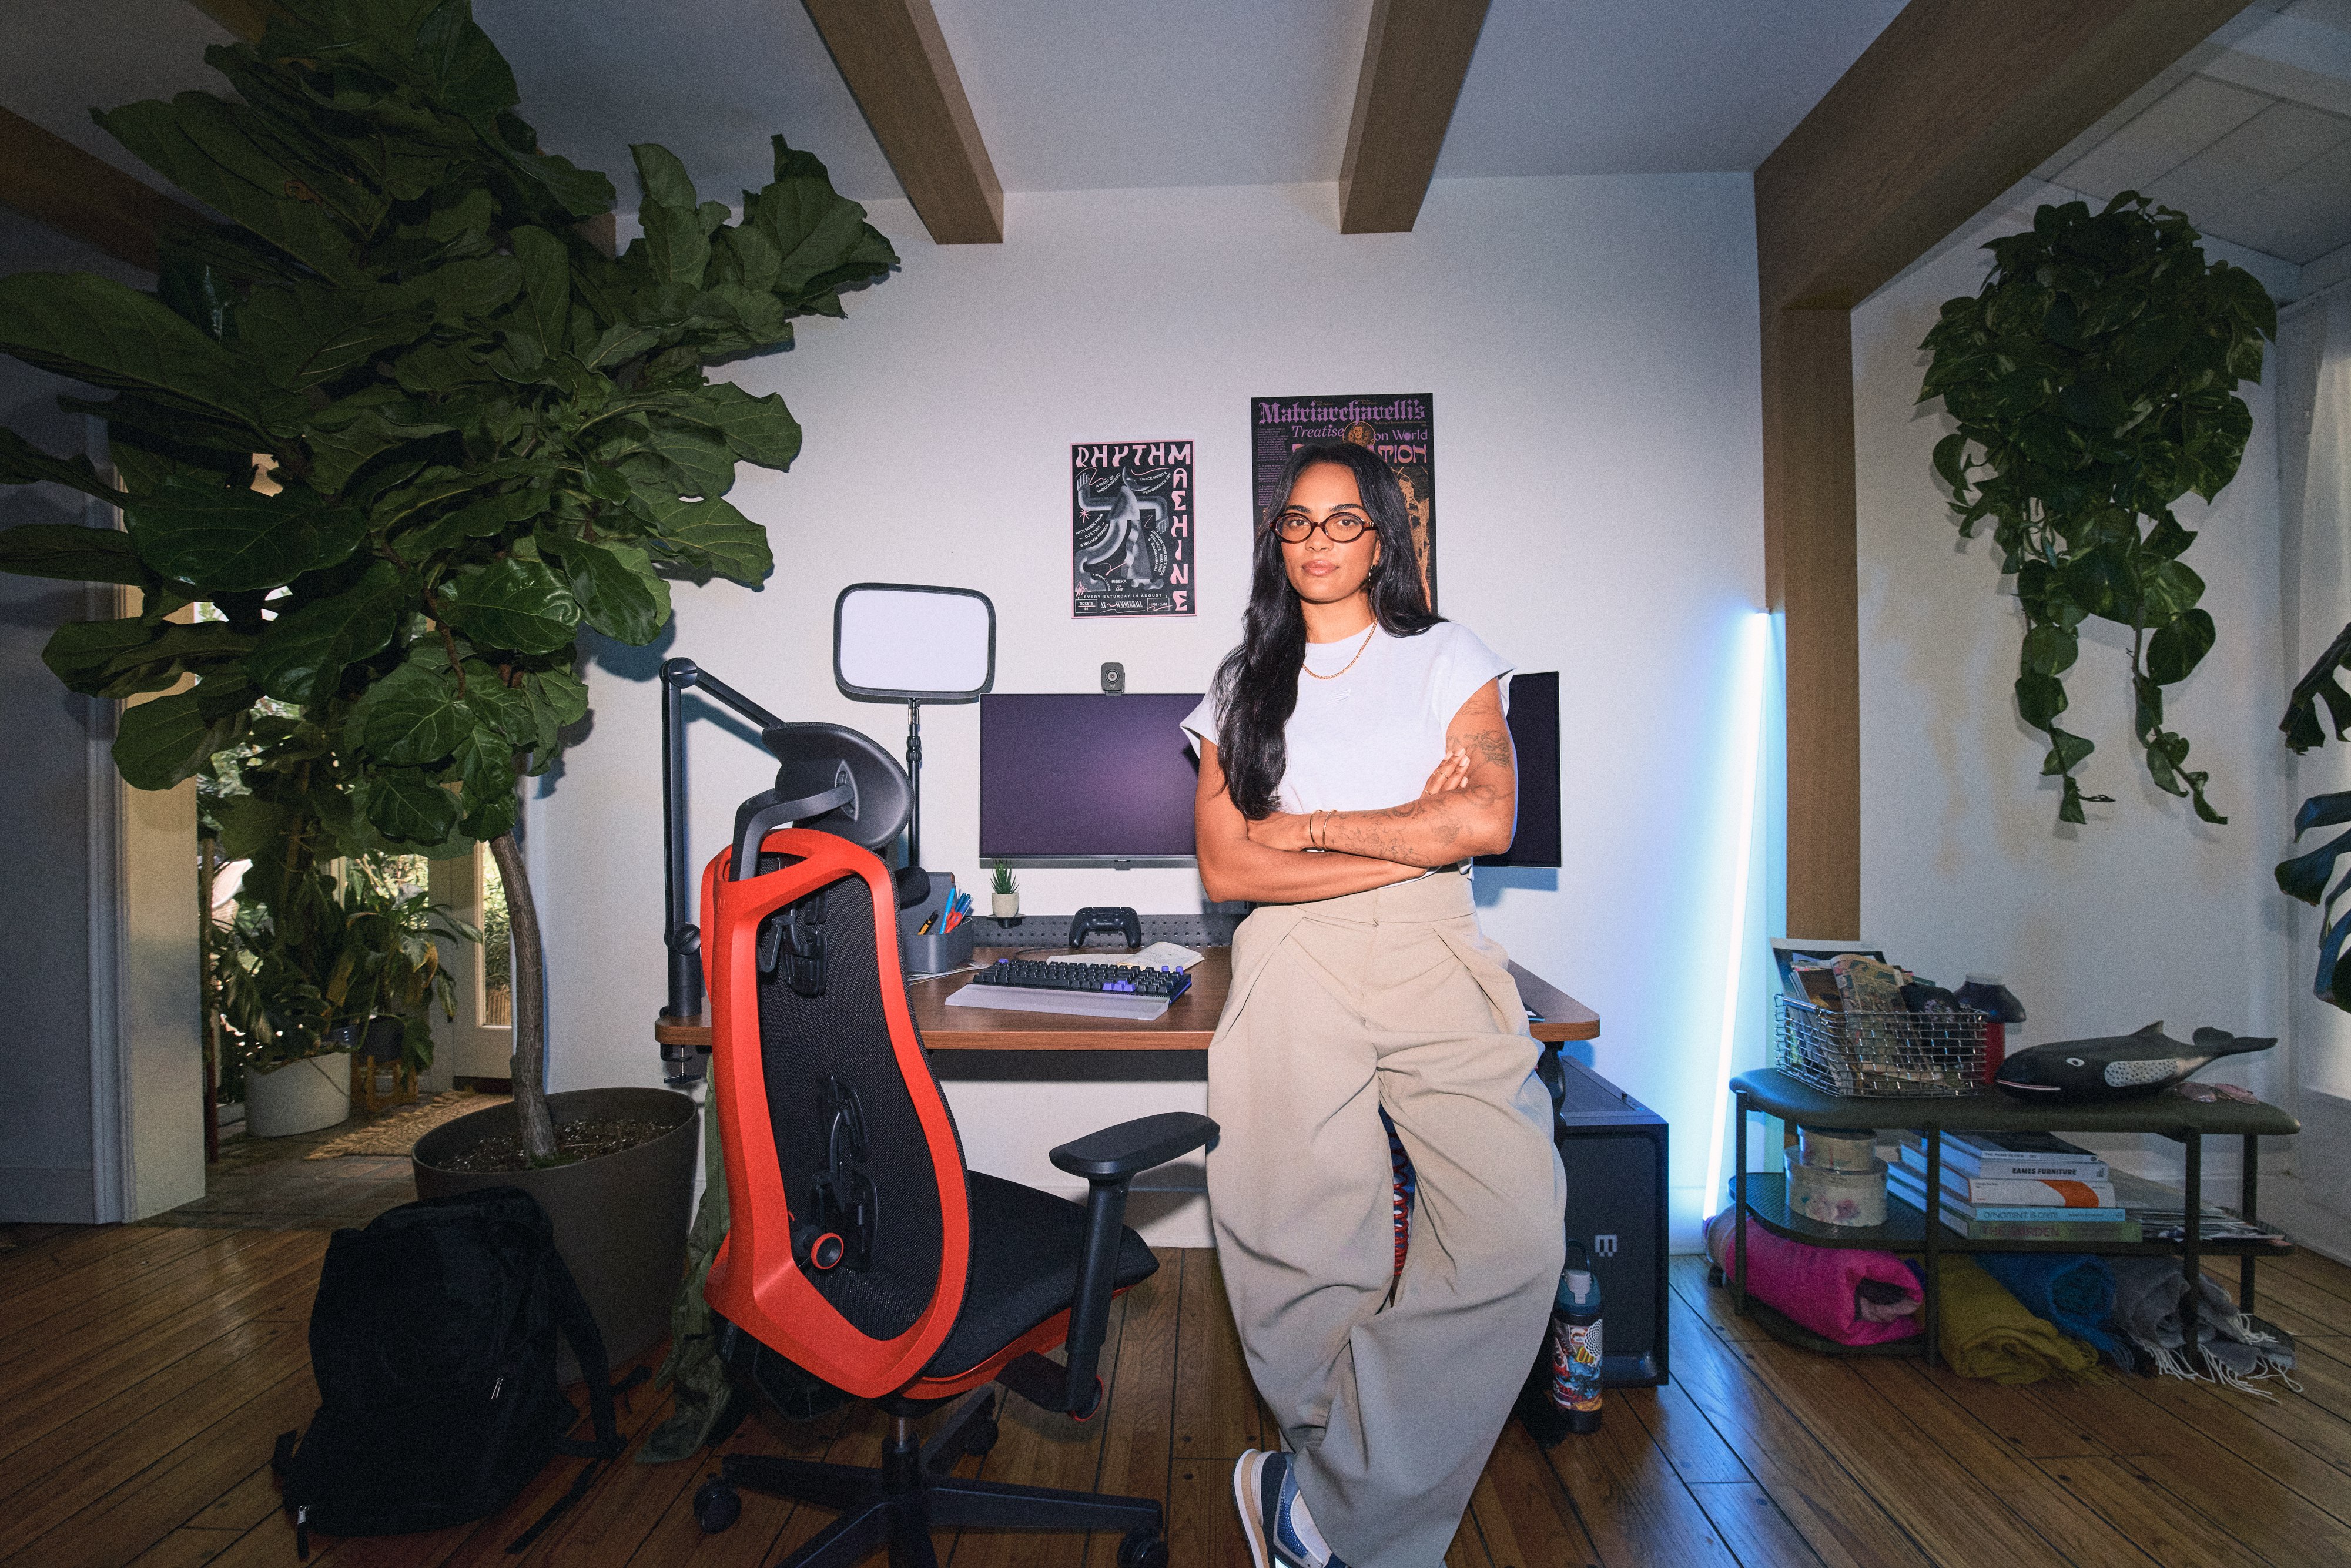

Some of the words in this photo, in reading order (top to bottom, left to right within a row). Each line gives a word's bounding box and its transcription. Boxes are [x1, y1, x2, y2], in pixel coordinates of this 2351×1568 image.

[1292, 424, 1345, 438] Treatise
[1374, 432, 1388, 441] on
[1392, 429, 1428, 441] World
[1076, 443, 1191, 468] RHYTHM
[1099, 478, 1110, 487] NIGHT
[1143, 479, 1167, 494] PERFORMANCE
[1084, 522, 1096, 531] MUSIC
[1094, 513, 1103, 524] FROM
[1083, 536, 1099, 546] WILLIAM
[1097, 523, 1109, 538] FRANCIS
[1092, 525, 1101, 534] YVES
[1150, 530, 1164, 545] ARTWORK
[1982, 1225, 2003, 1236] THE
